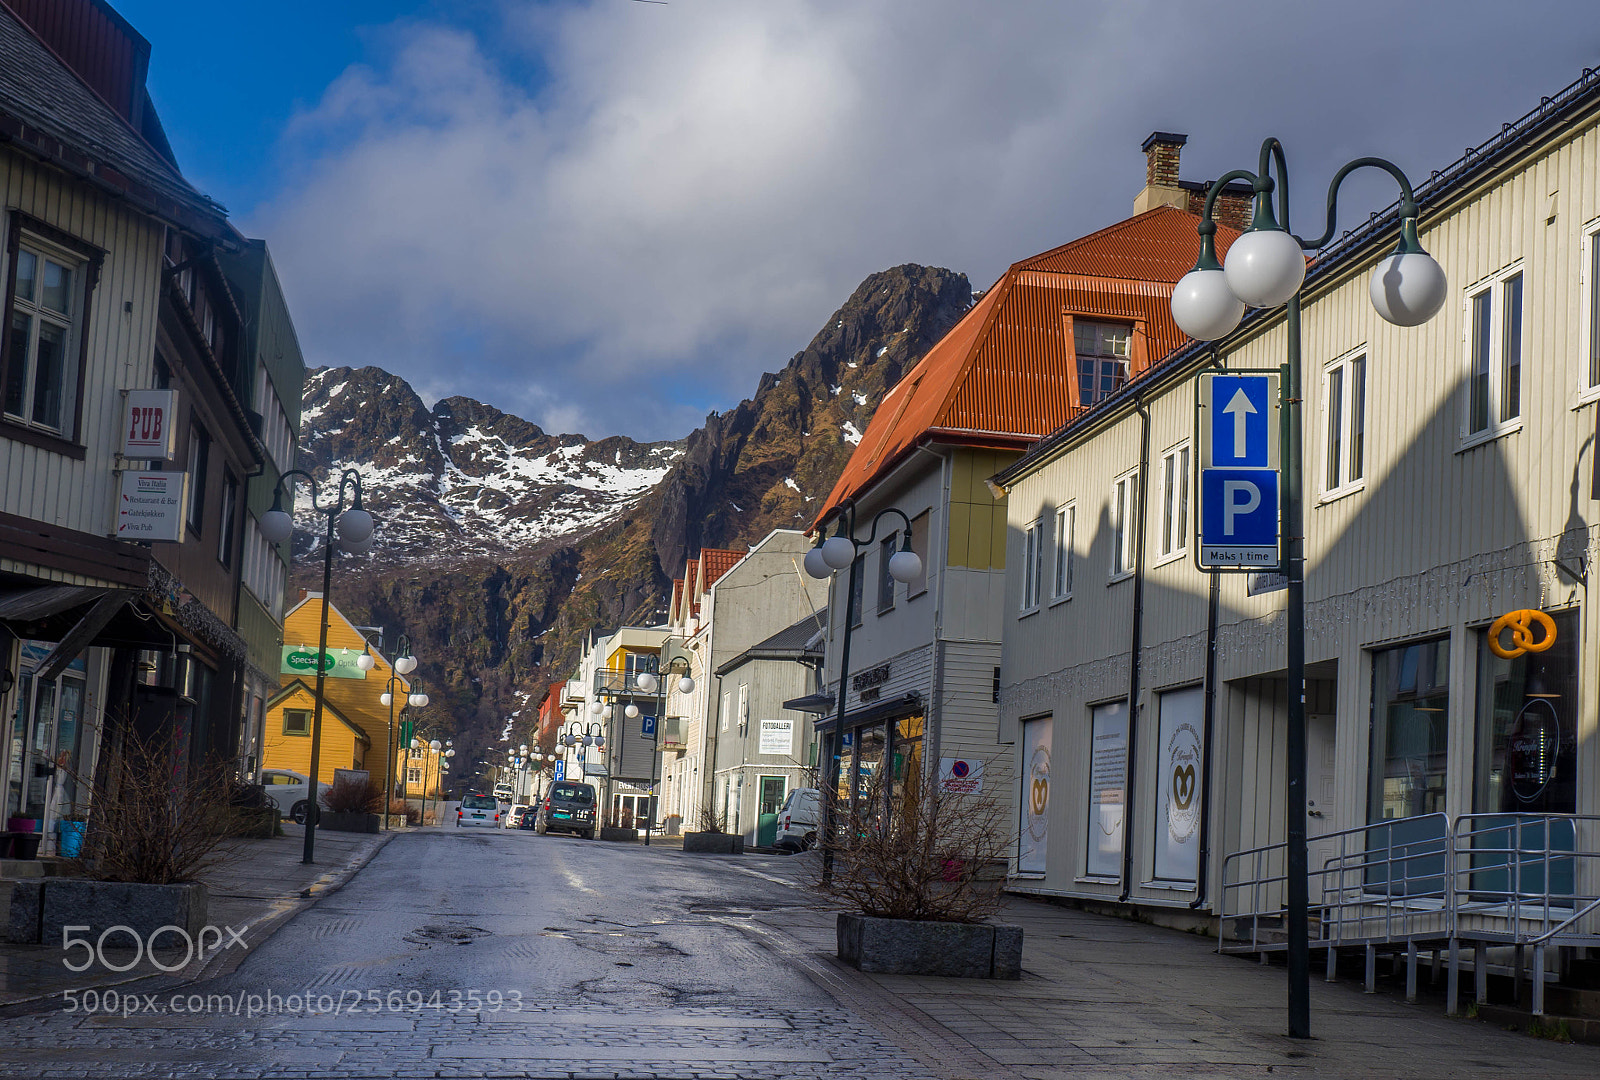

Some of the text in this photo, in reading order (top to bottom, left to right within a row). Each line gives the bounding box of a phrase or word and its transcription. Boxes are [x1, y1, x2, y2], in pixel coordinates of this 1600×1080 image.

[130, 407, 163, 440] PUB
[151, 480, 167, 488] Italia
[130, 496, 160, 504] Restaurant
[1224, 480, 1261, 536] P
[1210, 551, 1269, 561] Maks 1 time
[645, 718, 653, 732] P
[762, 721, 792, 730] FOTOGALLERI
[556, 773, 563, 781] P
